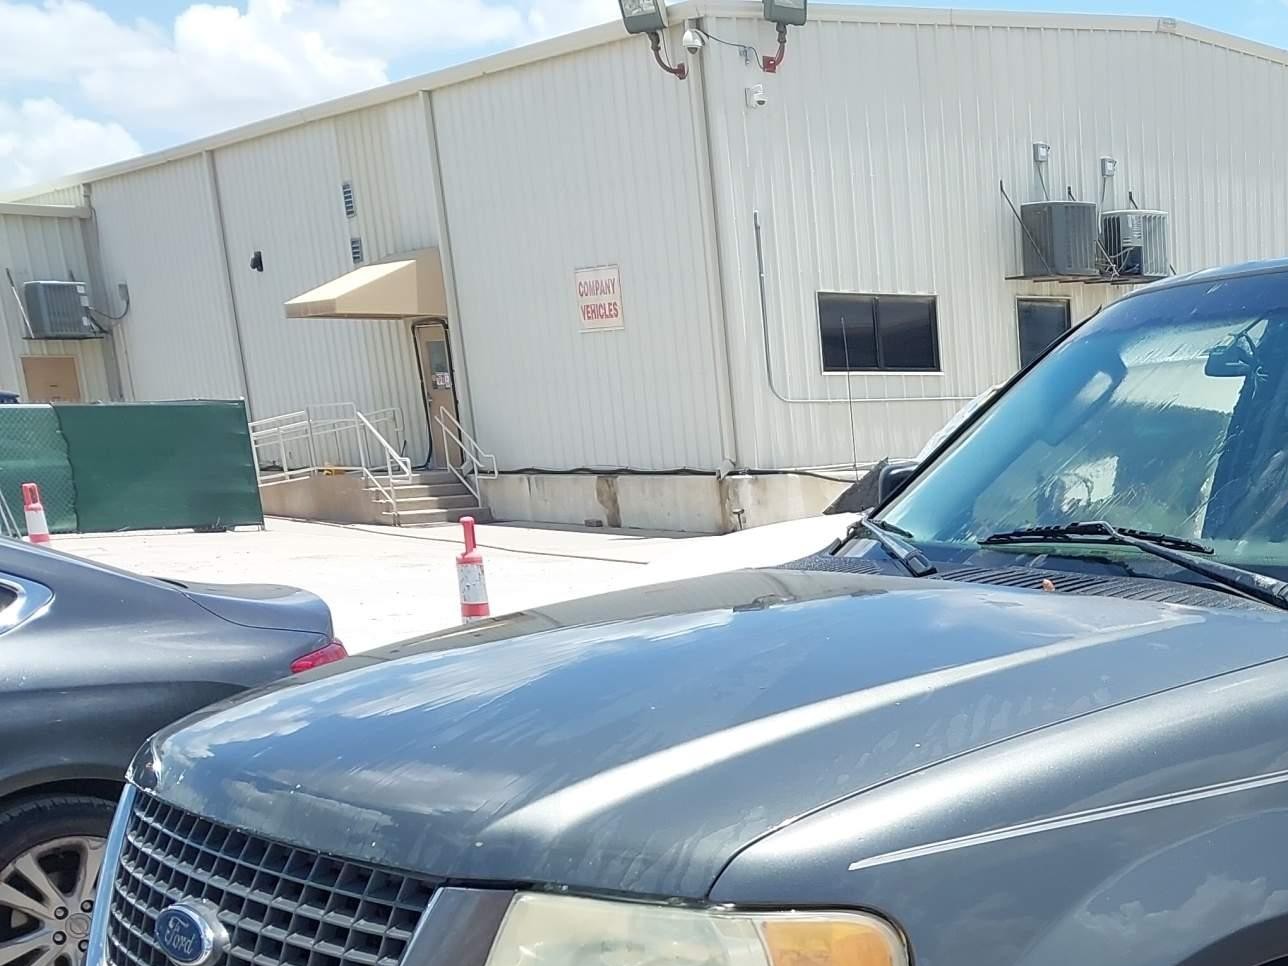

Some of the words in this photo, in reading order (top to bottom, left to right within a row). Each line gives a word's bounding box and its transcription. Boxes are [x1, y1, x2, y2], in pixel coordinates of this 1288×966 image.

[578, 278, 616, 297] COMPANY
[580, 302, 619, 321] VEHICLES
[164, 916, 196, 955] Ford
